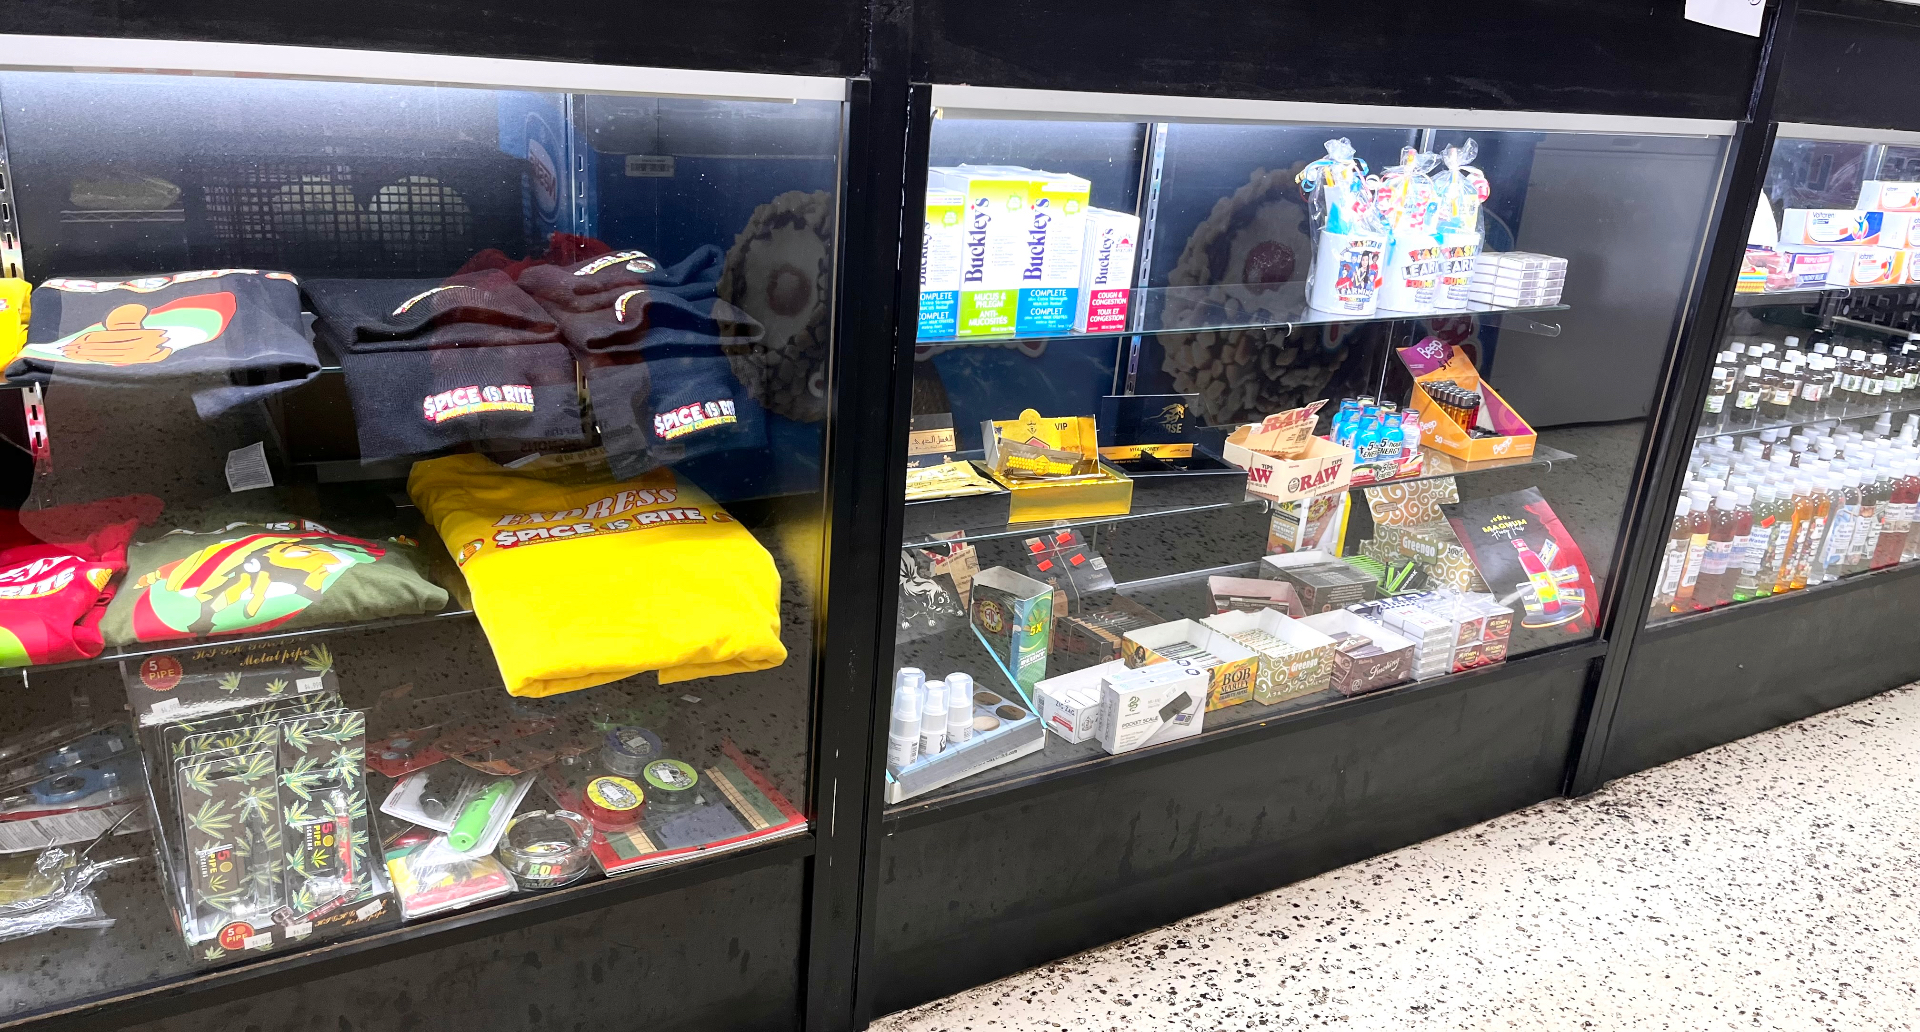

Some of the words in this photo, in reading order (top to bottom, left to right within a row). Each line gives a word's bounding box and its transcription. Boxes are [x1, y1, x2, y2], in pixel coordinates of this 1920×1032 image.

[1812, 211, 1835, 219] Voltaren
[964, 197, 991, 284] Buckley's
[1022, 198, 1052, 281] Buckley's
[1095, 228, 1114, 285] Buckley's
[920, 291, 953, 301] OMPLETE
[974, 292, 999, 301] MUCUS
[1000, 292, 1007, 300] &
[1030, 289, 1067, 297] COMPLETE
[975, 300, 1004, 308] PHLEGM
[1092, 298, 1127, 306] CONGESTION
[1030, 307, 1063, 315] COMPLET
[968, 316, 1008, 326] MUCOSITÉS
[1090, 315, 1125, 323] CONGESTION
[1416, 339, 1443, 359] Beep
[484, 386, 500, 401] IS
[501, 385, 534, 403] RITE
[707, 402, 719, 417] IS
[1054, 422, 1068, 431] VIP
[1261, 407, 1318, 435] RAW
[1419, 421, 1437, 435] Beep
[1380, 438, 1388, 448] 5
[1434, 435, 1443, 444] 50
[1492, 437, 1513, 455] Beep
[1262, 463, 1274, 471] TIPS
[1331, 457, 1343, 465] TIPS
[1246, 470, 1273, 484] AW
[1299, 464, 1343, 492] RAW
[492, 488, 678, 527] EXPRESS
[607, 519, 625, 531] IS
[636, 507, 707, 525] RITE
[1481, 518, 1528, 533] MAGNUM
[1402, 536, 1436, 557] Greengo
[1029, 621, 1043, 637] 5X
[281, 647, 311, 664] pipe
[148, 660, 158, 672] 5
[1290, 658, 1318, 672] Greengo
[1368, 657, 1411, 681] Smoking
[148, 668, 176, 681] PIPE
[1223, 667, 1251, 685] BOB
[1221, 680, 1249, 693] MARLEY
[1121, 719, 1142, 729] POCKET
[1142, 715, 1159, 724] SCALE
[322, 823, 333, 832] 5
[313, 824, 322, 847] PIPE
[217, 850, 231, 861] 5
[209, 853, 218, 874] PIPE
[528, 863, 563, 875] BOB
[227, 927, 235, 936] 5
